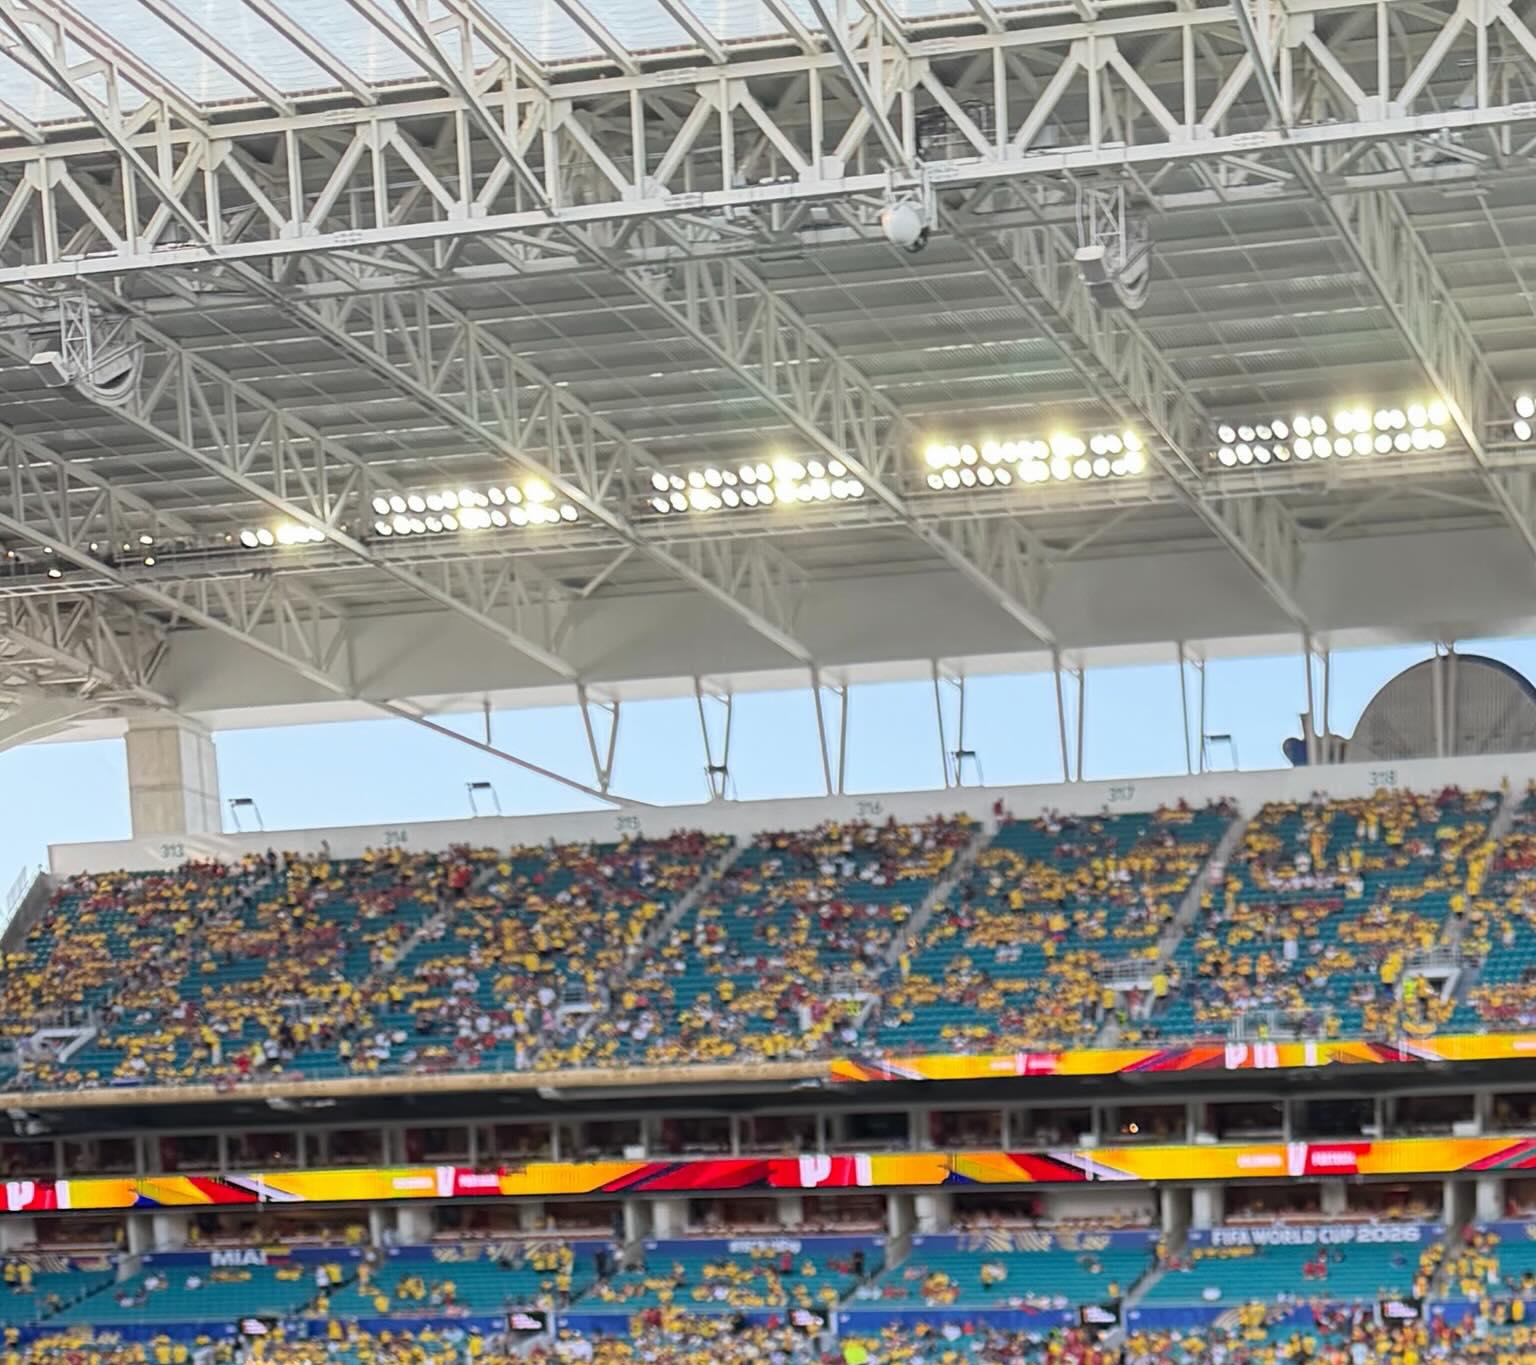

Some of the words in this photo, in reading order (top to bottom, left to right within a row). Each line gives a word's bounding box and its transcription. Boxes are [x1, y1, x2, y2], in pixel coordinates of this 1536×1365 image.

[1211, 1229, 1250, 1246] FIFA
[1251, 1228, 1316, 1245] WORLD
[1318, 1227, 1355, 1245] CUP
[1356, 1226, 1421, 1243] 2026
[210, 1249, 268, 1267] MIA
